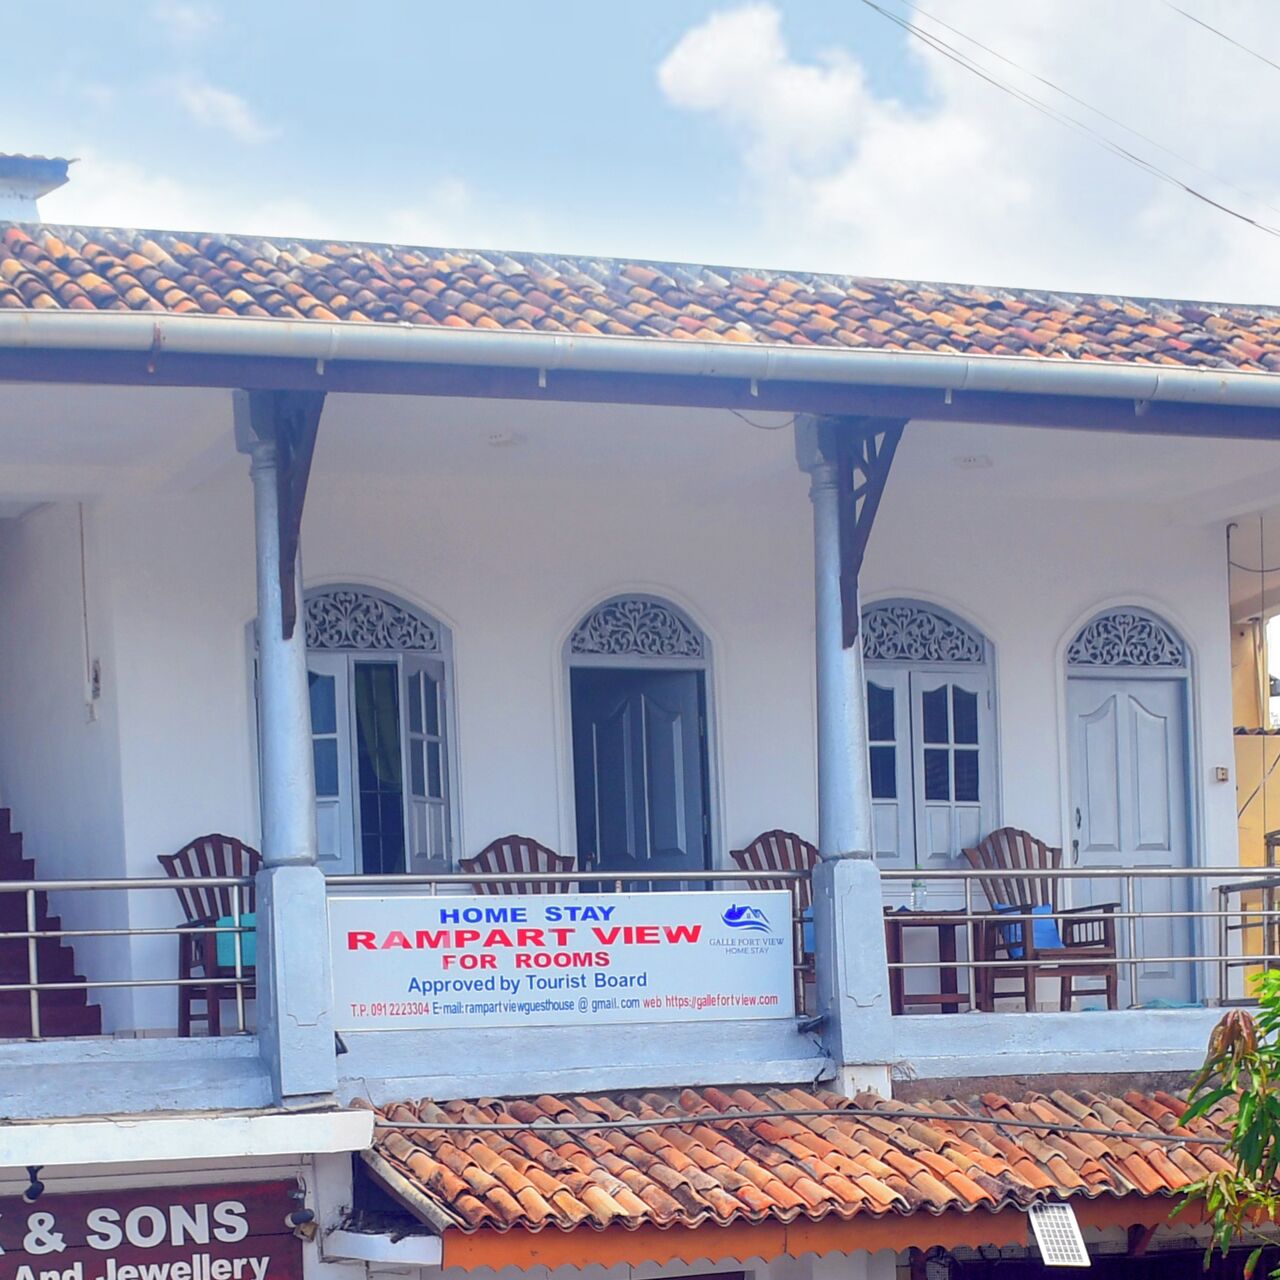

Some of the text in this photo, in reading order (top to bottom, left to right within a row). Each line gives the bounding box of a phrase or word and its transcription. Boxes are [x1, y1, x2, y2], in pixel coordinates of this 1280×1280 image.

[439, 906, 616, 924] HOME STAY
[347, 924, 702, 949] RAMPART VIEW
[709, 938, 735, 946] GALLE
[763, 937, 784, 945] VIEW
[442, 951, 611, 970] FOR ROOMS
[725, 946, 769, 955] HOME STAY
[408, 972, 648, 995] Approved by Tourist Board
[351, 1004, 369, 1017] T.P.
[643, 996, 662, 1009] web
[23, 1211, 67, 1255] &
[86, 1201, 250, 1249] SONS
